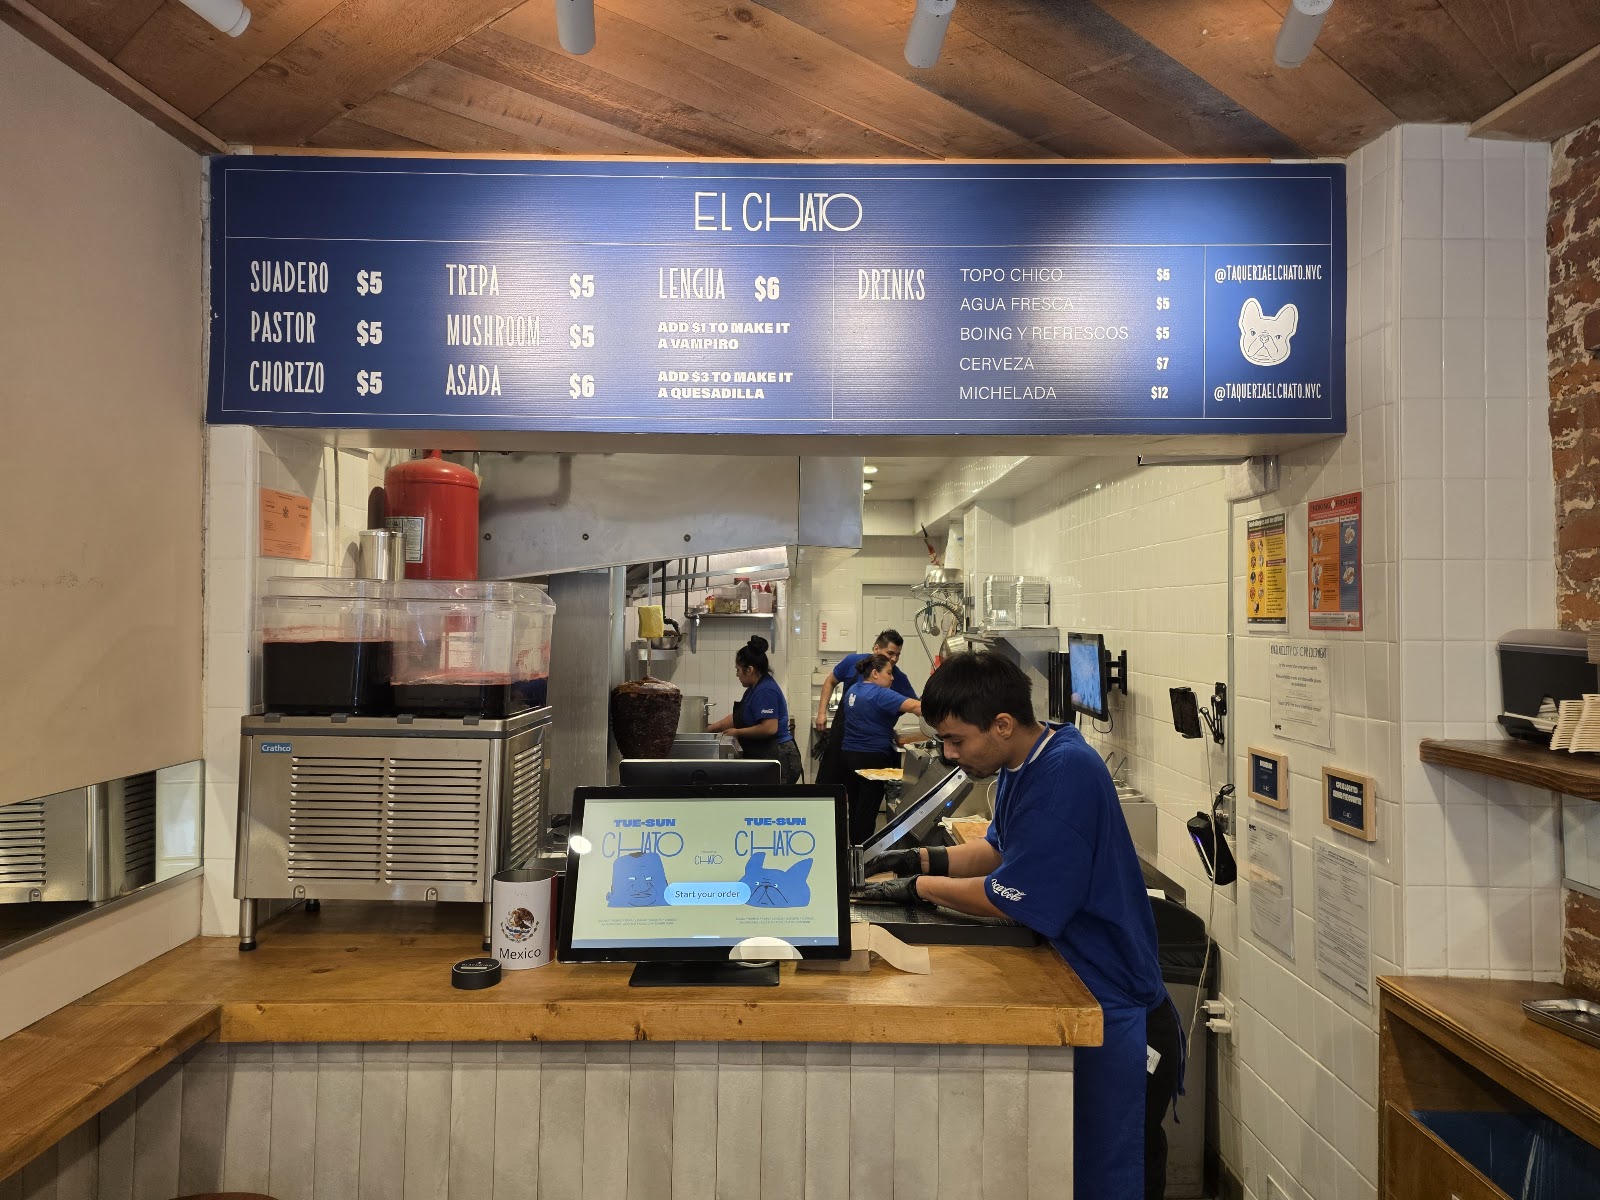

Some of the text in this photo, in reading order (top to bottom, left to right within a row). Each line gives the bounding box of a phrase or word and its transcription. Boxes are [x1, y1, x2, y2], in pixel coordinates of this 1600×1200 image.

[694, 191, 863, 232] EL CHATO
[250, 260, 383, 296] SUADERO $5
[445, 263, 595, 299] TRIPA $5
[960, 268, 1005, 282] TOPO
[1010, 268, 1063, 282] CHICO
[1214, 264, 1323, 284] @TAQUERIAELCHATO.NYC
[658, 267, 780, 302] LENGUA $6
[858, 268, 926, 301] DRINKS
[960, 296, 1170, 311] AGUA FRESCA $5
[250, 310, 383, 347] PASTOR $5
[446, 314, 595, 349] MUSHROOM $5
[658, 321, 791, 334] ADD $1 TO MAKE IT
[960, 326, 1170, 341] BOING Y REFRESCOS $5
[657, 338, 739, 350] A VAMPIRO
[959, 357, 1170, 371] CERVEZA $7
[249, 361, 383, 397] CHORIZO $5
[445, 364, 595, 399] ASADA $6
[658, 371, 794, 383] ADD $3 TO MAKE IT
[657, 387, 765, 400] A QUESADILLA
[959, 386, 1169, 400] MICHELADA $12
[1214, 382, 1322, 402] @TAQUERIAELCHATO.NYC
[613, 818, 676, 828] TUE-SUN
[744, 817, 807, 826] TUE-SUN
[601, 831, 684, 858] CHATO
[734, 830, 816, 857] CHATO
[675, 889, 741, 902] Start your order
[499, 947, 542, 960] Mexico
